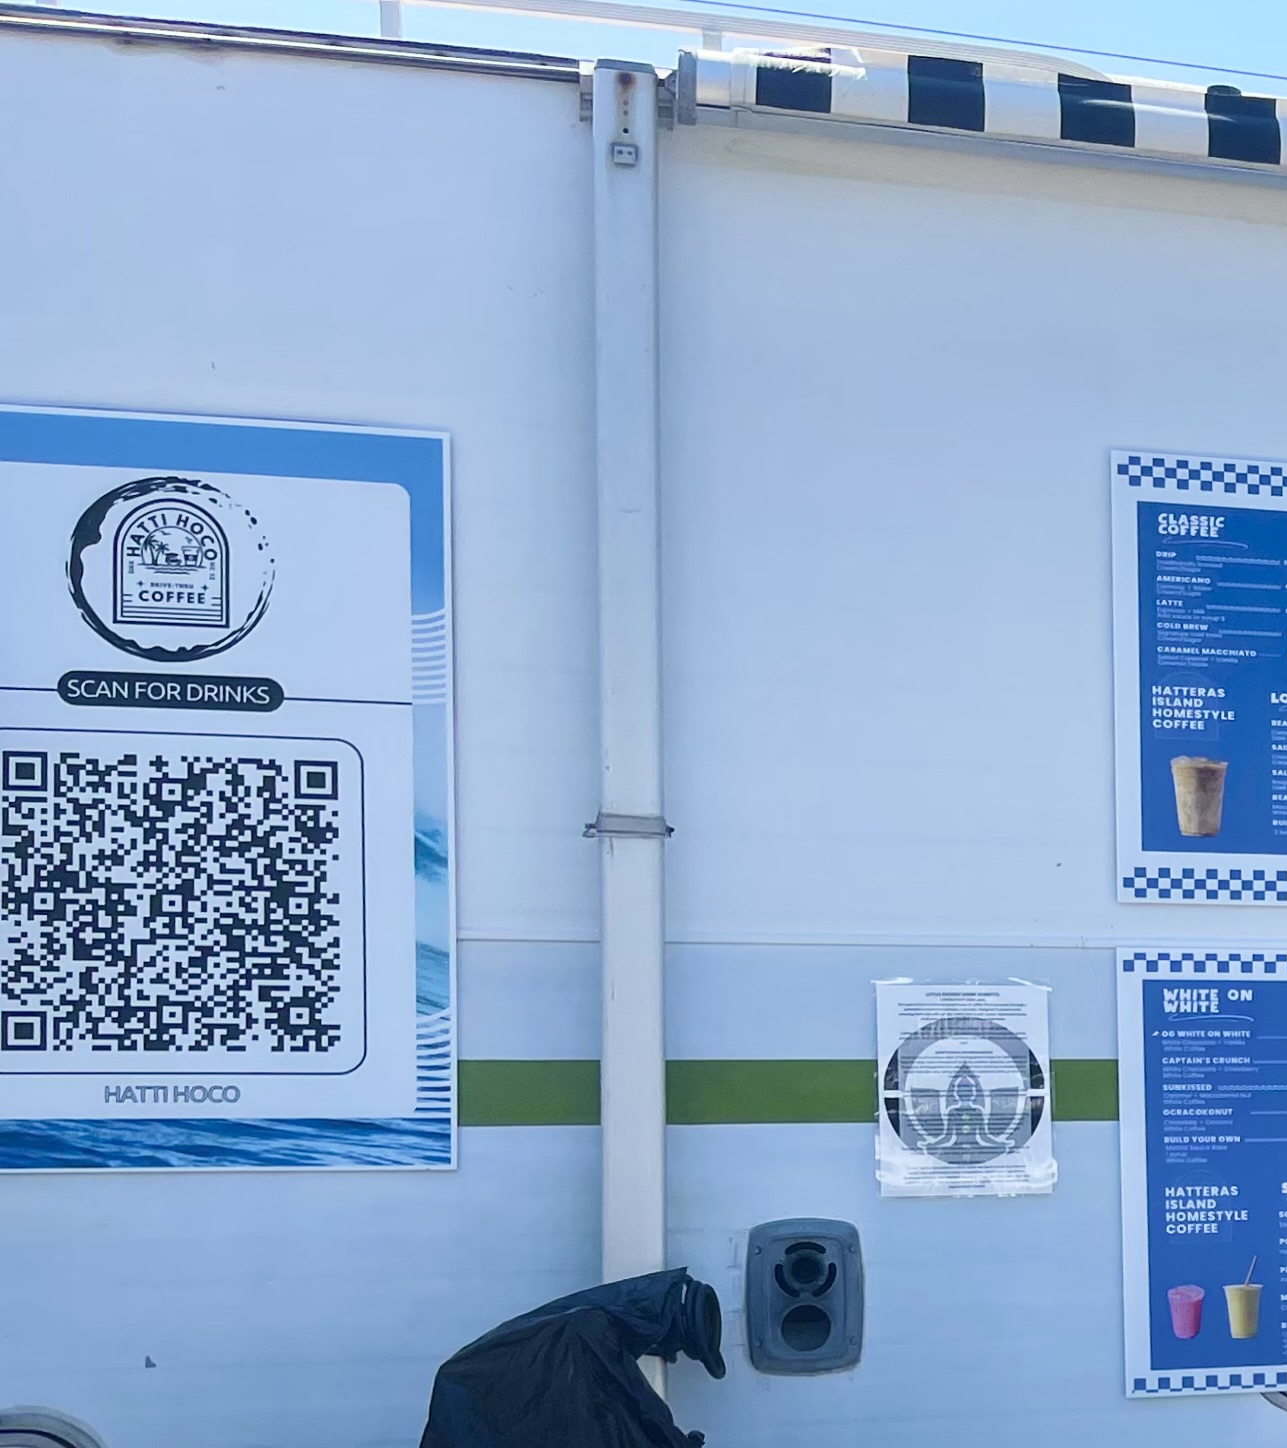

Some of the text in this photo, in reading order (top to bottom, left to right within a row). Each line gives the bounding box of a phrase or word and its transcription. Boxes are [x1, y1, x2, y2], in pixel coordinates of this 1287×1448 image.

[1158, 514, 1224, 527] CLASSIC
[127, 514, 217, 561] HATTI HOCO
[1158, 525, 1219, 538] COFFEE
[1156, 576, 1210, 584] AMERICANO
[139, 590, 205, 604] COFFEE
[1156, 622, 1208, 631] COLD BREW
[1157, 646, 1256, 657] CARAMEL MACCHIATO
[68, 679, 269, 704] SCAN FOR DRINKS
[1152, 686, 1225, 698] HATTERAS
[1152, 696, 1204, 708] ISLAND
[1152, 708, 1235, 720] HOMESTYLE
[1152, 718, 1204, 730] COFFEE
[1163, 988, 1252, 1001] WHITE ON
[1163, 1001, 1219, 1013] WHITE
[1162, 1030, 1251, 1038] OG WHITE ON WHITE
[104, 1085, 240, 1103] HATTI HOCO
[1162, 1108, 1232, 1116] OCRACOKONUT
[1165, 1186, 1238, 1197] HATTERAS
[1166, 1198, 1216, 1209] ISLAND
[1166, 1210, 1248, 1222] HOMESTYLE
[1166, 1224, 1218, 1234] COFFEE
